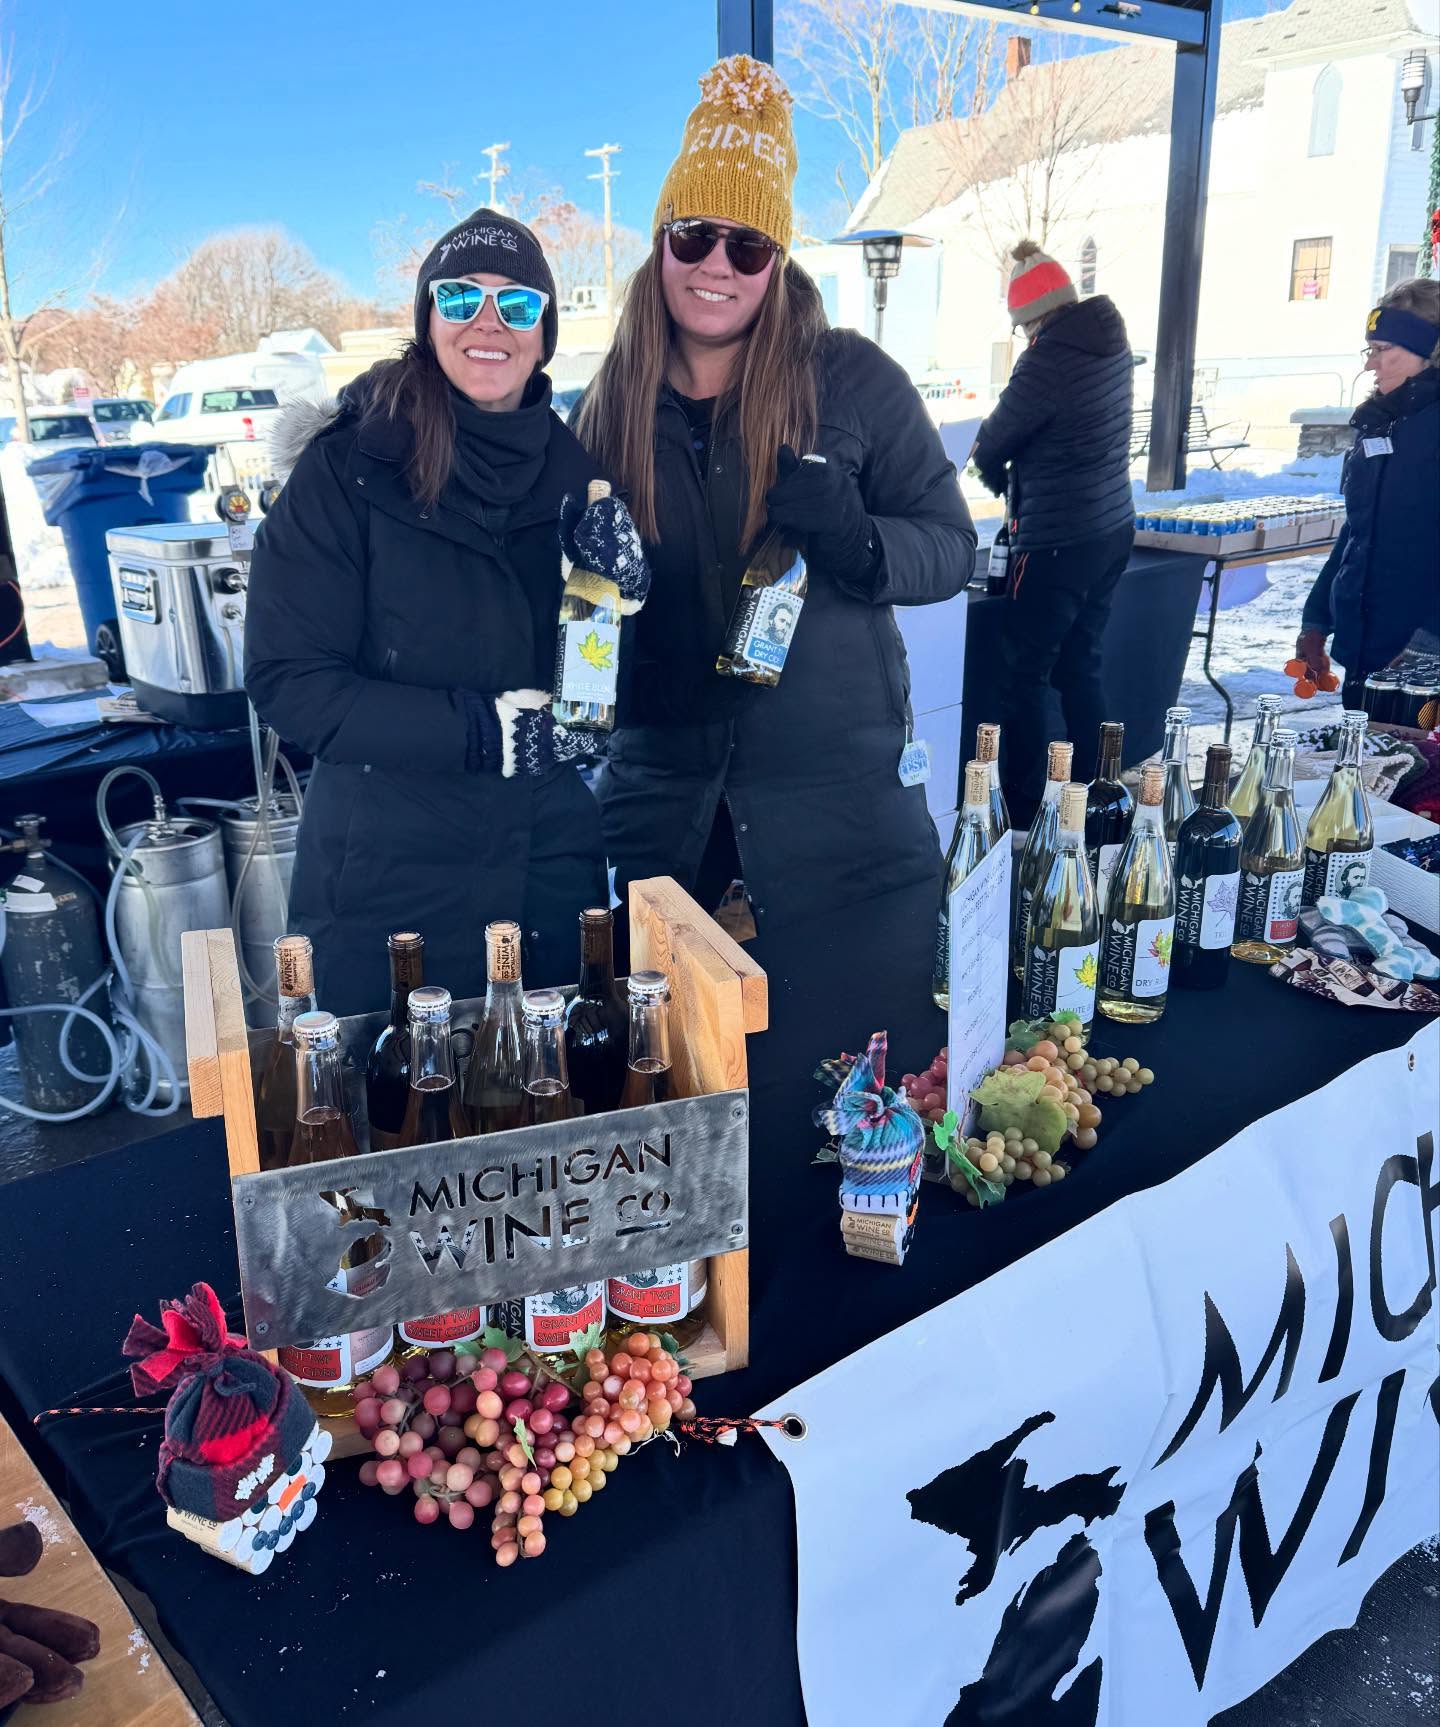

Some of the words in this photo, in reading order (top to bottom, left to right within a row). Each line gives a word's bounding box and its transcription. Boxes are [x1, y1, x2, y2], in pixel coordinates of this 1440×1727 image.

[451, 234, 499, 252] WINE
[500, 238, 518, 252] CO
[452, 226, 518, 242] MICHIGAN
[734, 601, 757, 654] MICHIGAN
[753, 640, 777, 653] GRANT
[754, 649, 768, 659] DRY
[554, 640, 567, 698] MICHIGAN
[1303, 864, 1316, 897] WINE
[1314, 866, 1325, 900] MICHIG
[1176, 889, 1190, 927] WINE
[1240, 886, 1256, 923] WINE
[1252, 888, 1266, 939] MICHIGAN
[1021, 901, 1031, 941] WINE
[1188, 890, 1201, 944] MICHIGAN
[1176, 927, 1184, 941] CO
[1241, 923, 1250, 935] CO
[935, 926, 946, 966] WINE
[1107, 934, 1122, 974] WINE
[501, 945, 511, 970] WINE
[1120, 936, 1134, 992] MICHIGAN
[283, 958, 293, 983] WINE
[501, 970, 511, 979] CO
[935, 965, 942, 978] CO
[1031, 961, 1045, 1002] WINE
[1107, 974, 1117, 988] CO
[1135, 979, 1153, 987] DRY
[1030, 1001, 1040, 1017] CO
[408, 1133, 671, 1217] MICHIGAN
[409, 1198, 590, 1276] WINE
[614, 1189, 672, 1230] CO
[857, 1218, 891, 1230] MICHIGAN
[857, 1224, 881, 1234] WINE
[881, 1228, 891, 1236] CO
[861, 1247, 886, 1258] WINE
[650, 1290, 674, 1301] TWP
[453, 1307, 475, 1322] TWP
[541, 1315, 579, 1330] GRANT
[582, 1303, 601, 1319] TWP
[644, 1302, 677, 1315] CIDER
[407, 1323, 441, 1339] SWEET
[444, 1320, 477, 1338] CIDER
[537, 1330, 569, 1344] SWEE
[302, 1366, 337, 1378] CIDER
[184, 1510, 207, 1527] WINE
